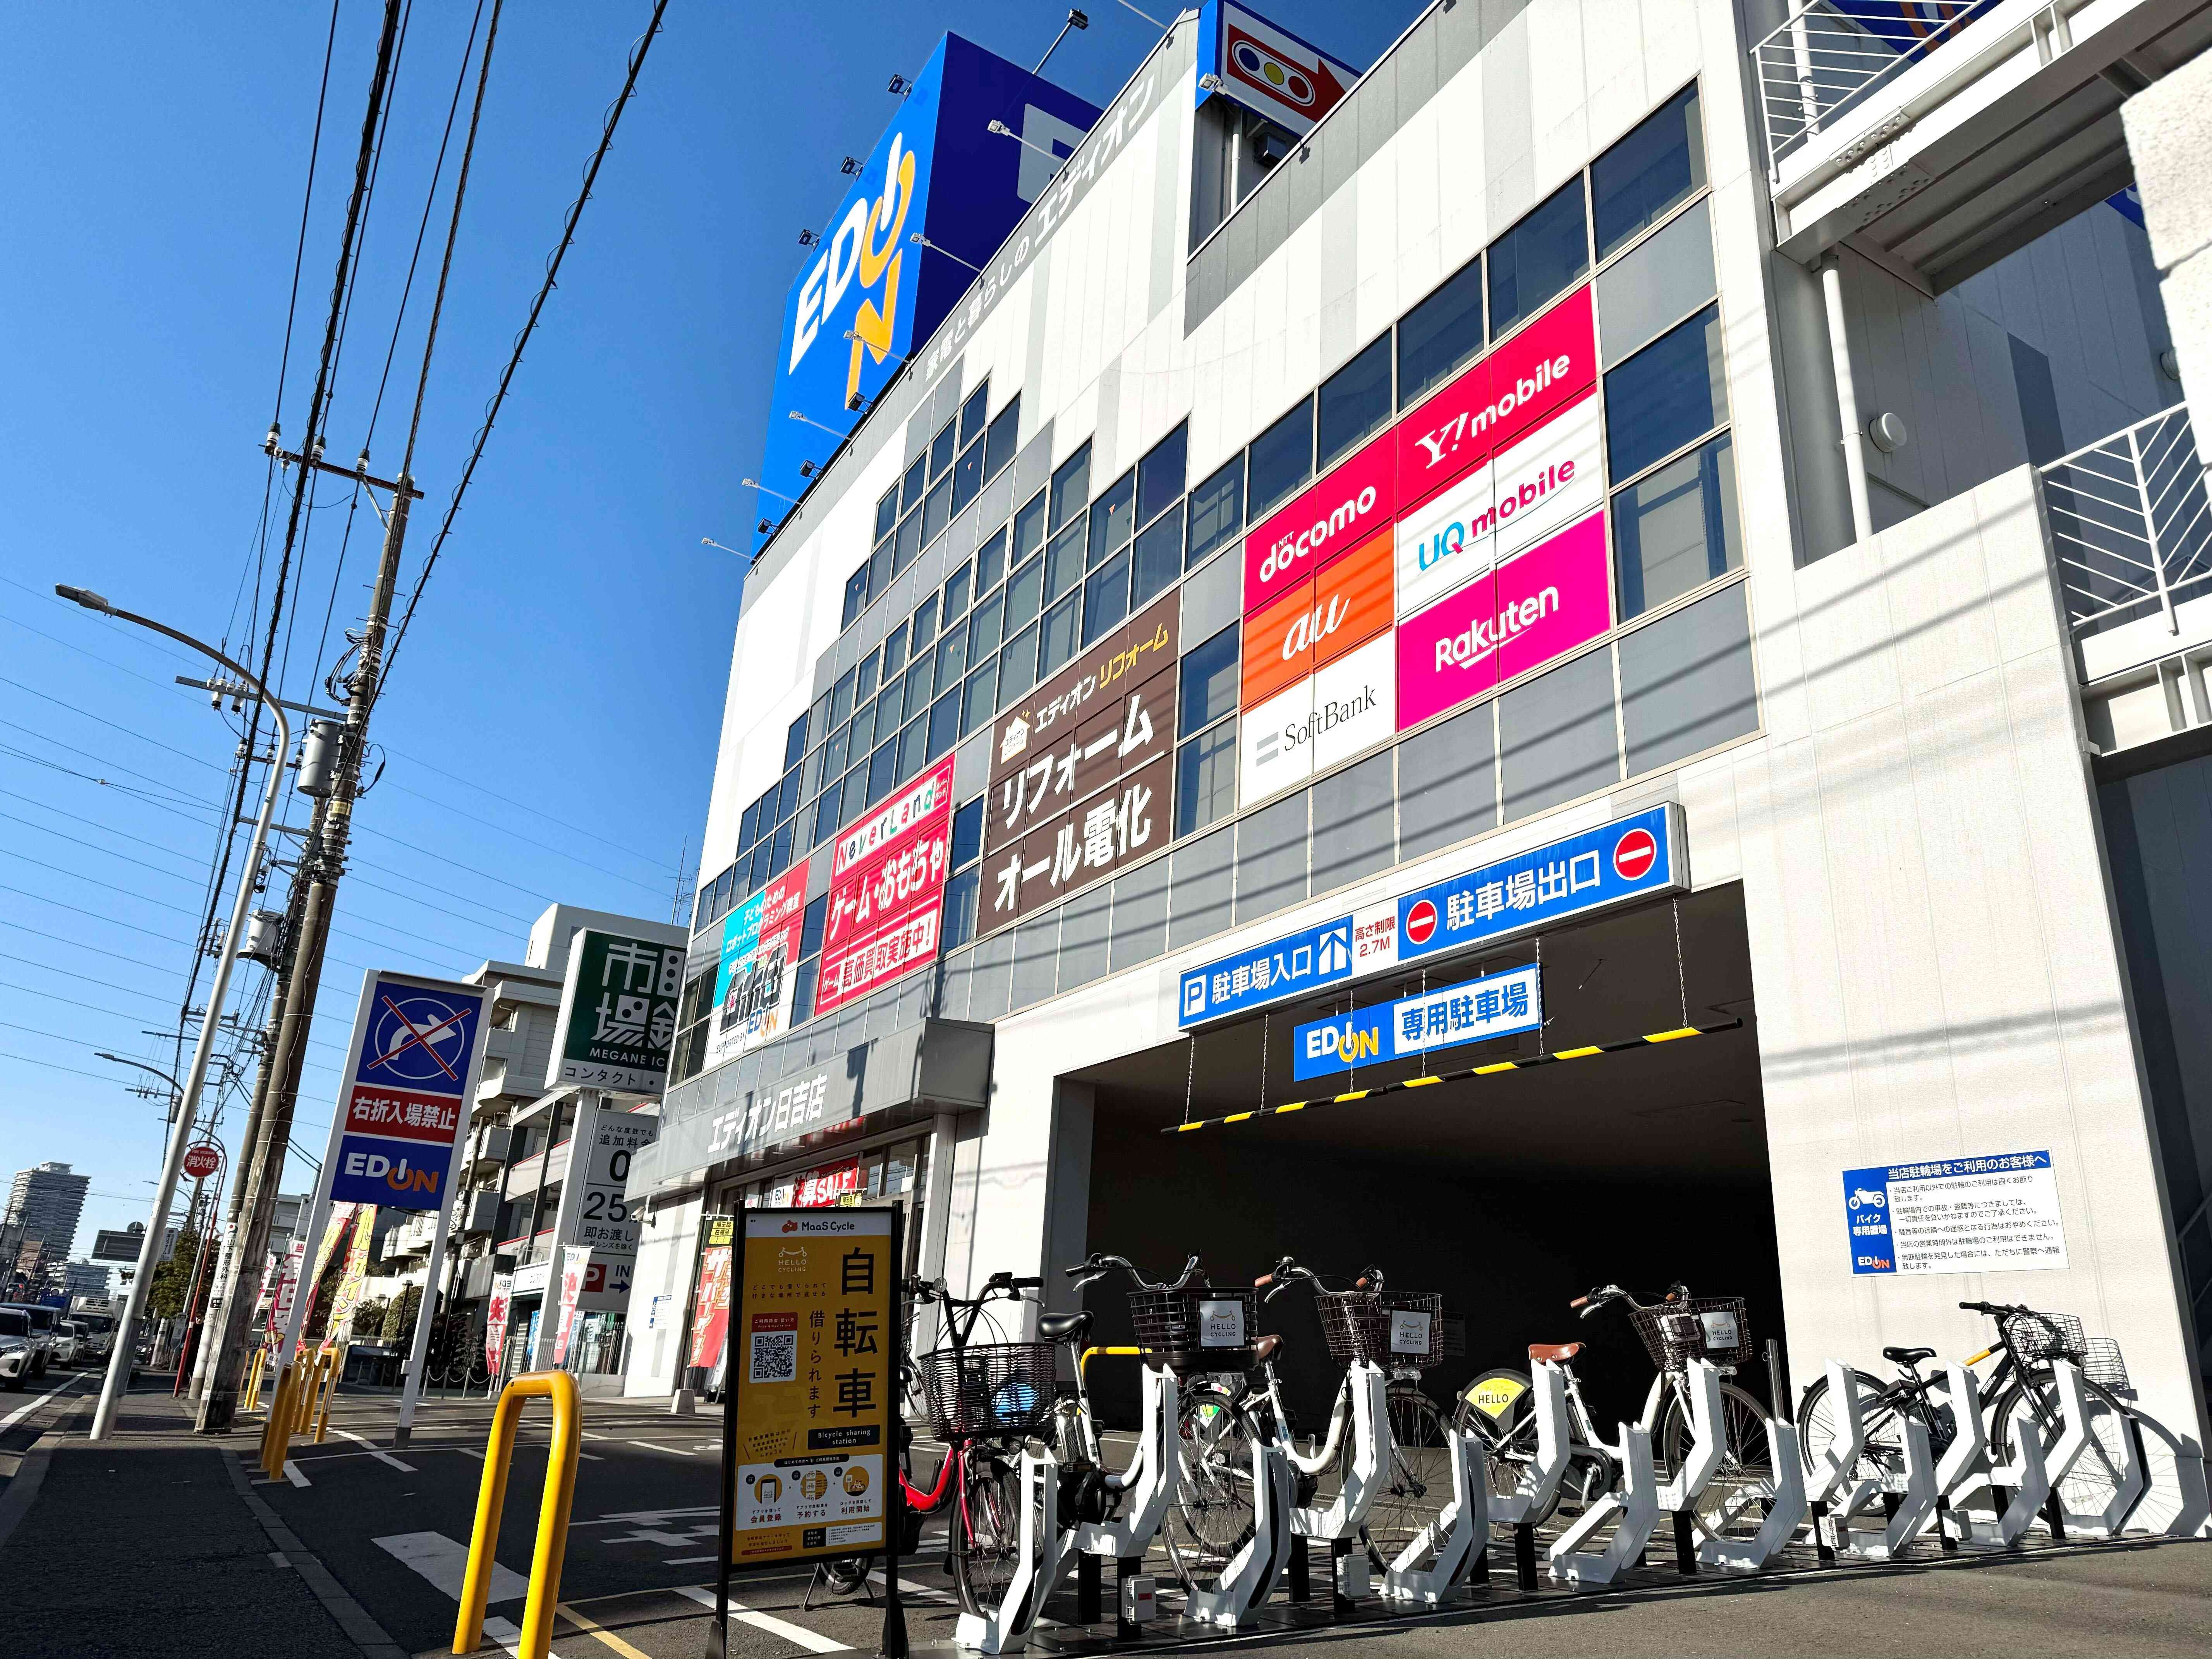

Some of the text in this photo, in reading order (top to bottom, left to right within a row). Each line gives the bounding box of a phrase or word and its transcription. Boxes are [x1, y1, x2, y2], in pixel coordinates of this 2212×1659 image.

[1035, 73, 1154, 247] エディオン
[788, 132, 915, 410] EDION
[1418, 459, 1575, 573] UQ mobile
[1259, 485, 1377, 582] docomo
[1278, 530, 1294, 548] NTT
[1282, 592, 1350, 661] au
[1435, 586, 1559, 673] Rakuten
[1035, 623, 1169, 733] エディオン リフォーム
[1285, 683, 1376, 751] SoftBank
[1004, 694, 1154, 830] リフォーム
[994, 783, 1152, 912] オール電化
[830, 838, 943, 941] ゲーム・おもちゃ
[1447, 850, 1599, 932] 駐車場出口
[1355, 916, 1395, 942] 高さ制限
[1360, 936, 1389, 957] 2.7M
[1187, 944, 1311, 1010] P 駐車場入口
[748, 1003, 778, 1037] EDION
[1307, 983, 1527, 1063] EDION 専用駐車場
[589, 1047, 646, 1064] MEGANE
[354, 1097, 455, 1130] 右折入場禁止
[707, 1073, 827, 1154] エディオン日吉店
[601, 1124, 653, 1137] どんな度数でも
[186, 1156, 216, 1169] 消火栓
[344, 1152, 438, 1193] EDION
[1888, 1154, 2046, 1179] 当店駐輪場をご利用のお客様へ
[584, 1226, 633, 1242] 即お渡し
[802, 1221, 855, 1232] MaaS Cycle
[1853, 1226, 1887, 1236] 専用置場
[1856, 1214, 1881, 1224] バイク
[220, 1240, 235, 1280] 山下整形外科
[583, 1241, 632, 1250] 一部レンズを除く
[582, 1267, 599, 1290] P
[616, 1265, 630, 1277] IN
[1858, 1257, 1889, 1269] EDION
[833, 1247, 878, 1419] 自転車
[808, 1310, 825, 1419] 借りられます
[1479, 1394, 1508, 1403] HELLO
[818, 1431, 842, 1439] Bicycle
[751, 1514, 781, 1523] 会員登録
[797, 1510, 826, 1519] 予約する
[841, 1506, 869, 1514] 利用開始
